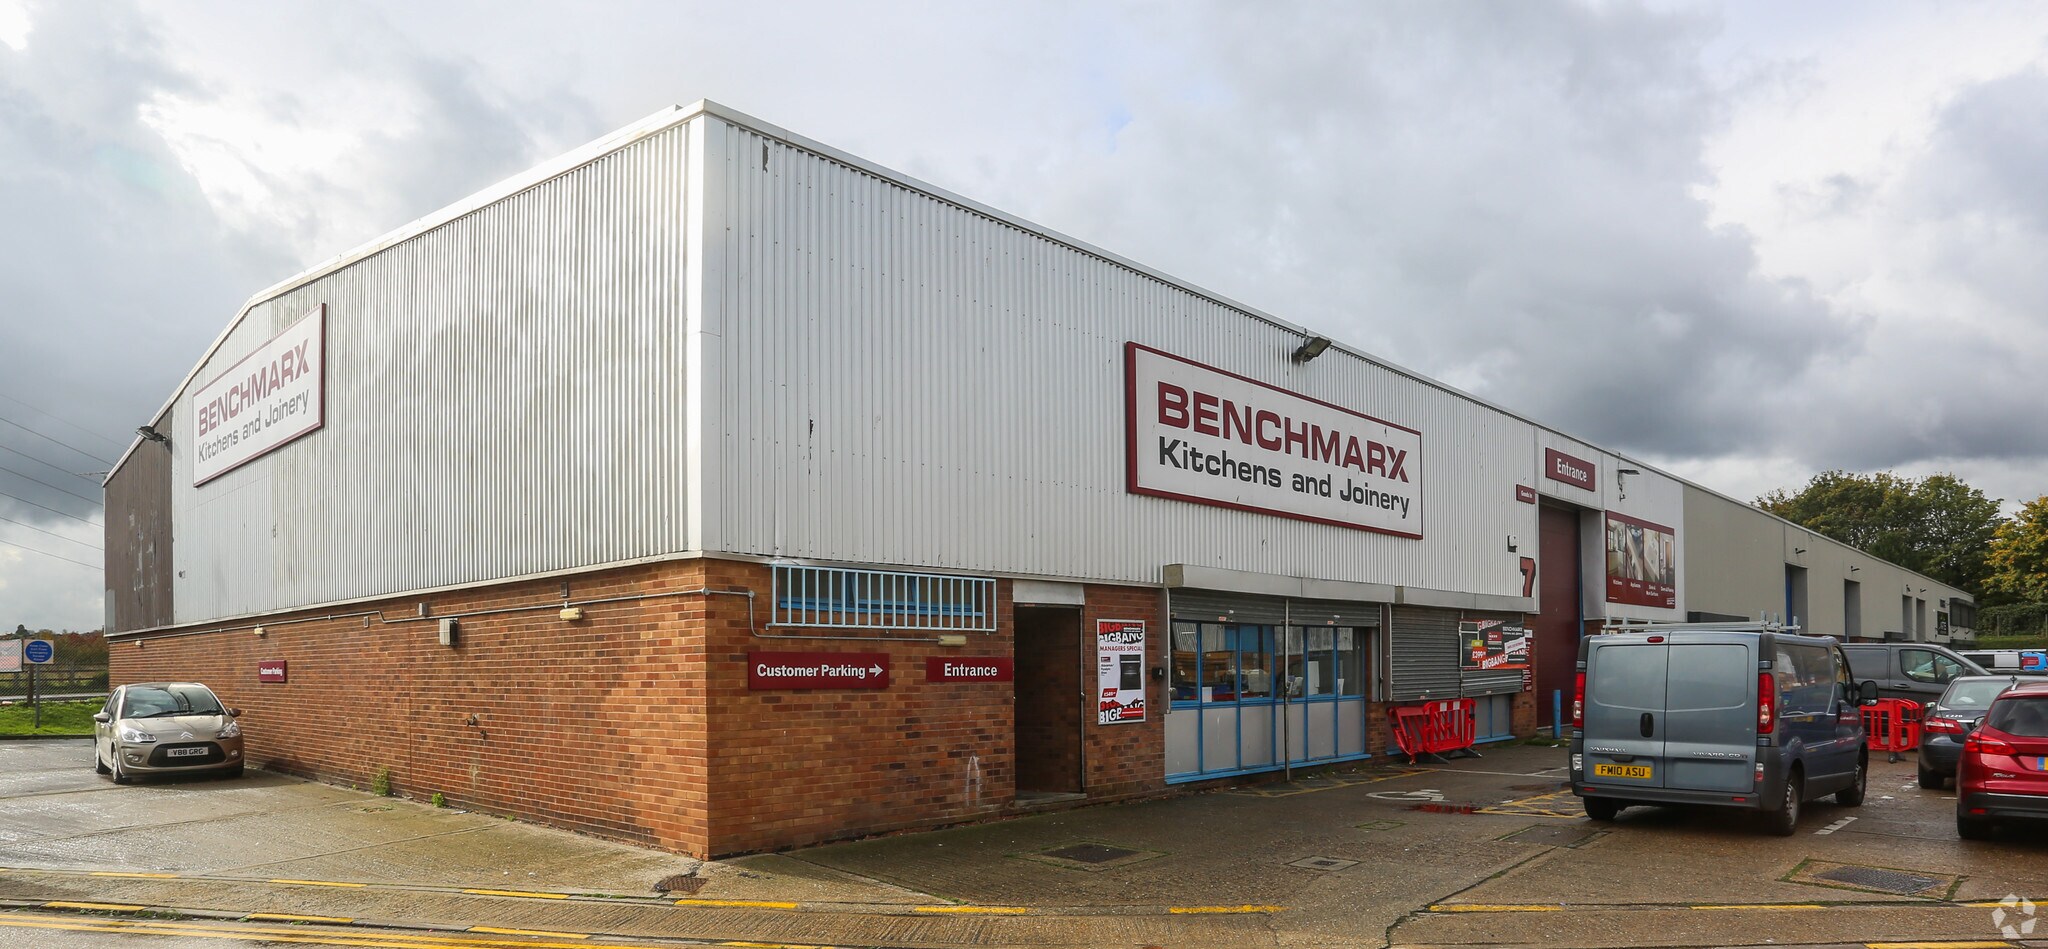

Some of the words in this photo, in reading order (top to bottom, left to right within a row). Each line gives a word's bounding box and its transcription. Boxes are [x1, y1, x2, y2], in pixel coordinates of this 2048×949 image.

[199, 338, 309, 437] BENCHMARX
[198, 429, 239, 463] Kitchens
[242, 410, 261, 441] and
[265, 389, 309, 428] Joinery
[1158, 381, 1409, 483] BENCHMARX
[1159, 436, 1282, 488] Kitchens
[1292, 472, 1331, 498] and
[1340, 478, 1410, 519] Joinery
[1557, 457, 1587, 482] Entrance
[1520, 556, 1536, 597] 7
[756, 664, 818, 677] Customer
[821, 664, 866, 679] Parking
[944, 663, 998, 677] Entrance
[1625, 767, 1645, 777] ASU
